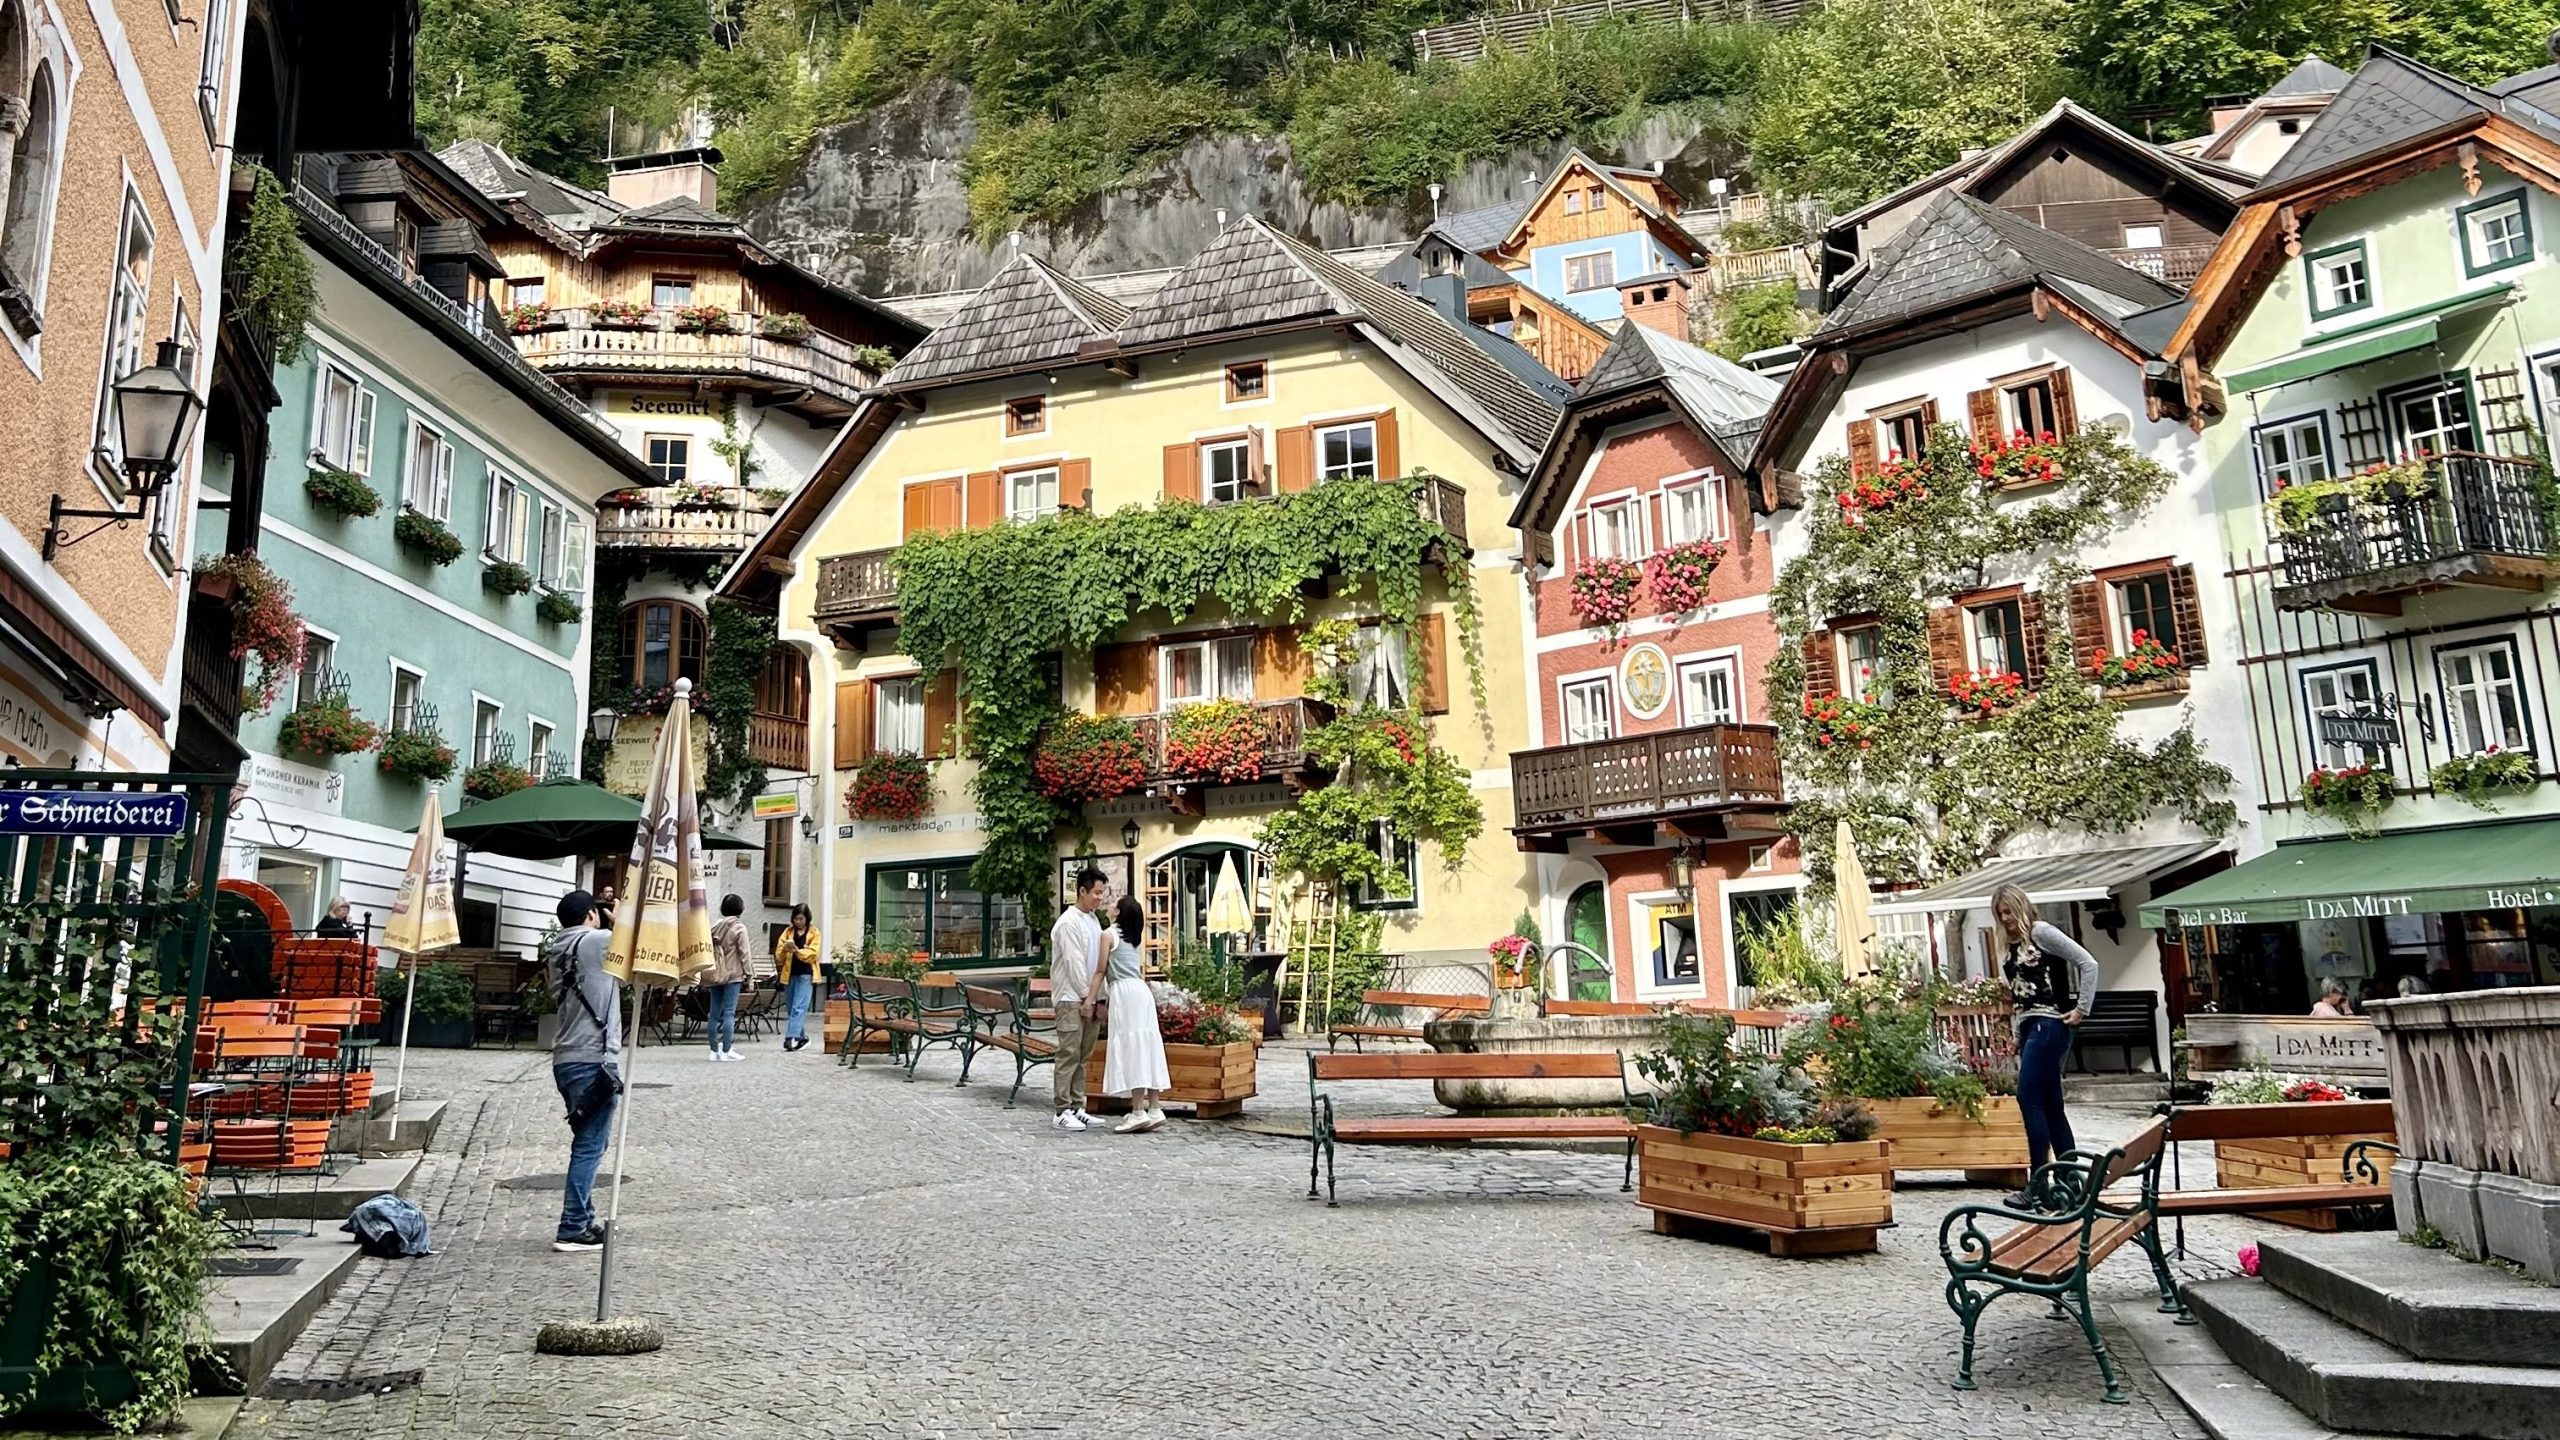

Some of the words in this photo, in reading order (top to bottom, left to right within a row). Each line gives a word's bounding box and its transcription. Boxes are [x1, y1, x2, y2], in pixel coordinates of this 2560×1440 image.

[630, 394, 710, 416] Seewirt
[2325, 719, 2353, 740] IDA
[2353, 720, 2392, 741] MITT
[616, 737, 650, 745] SEEWIRT
[293, 774, 320, 789] KERAMIK
[1219, 789, 1284, 806] SOUVENI
[20, 795, 175, 830] Schneiderei
[1101, 801, 1166, 816] ANDENKE
[879, 820, 952, 833] marktladen
[646, 876, 676, 902] IER.
[2486, 887, 2540, 909] Hotel
[427, 894, 447, 910] DAS
[1665, 903, 1687, 914] ATM
[2306, 898, 2348, 920] IDA
[2351, 895, 2412, 917] MITT
[2179, 910, 2202, 927] otel
[2220, 907, 2248, 924] Bar
[2276, 1034, 2312, 1056] IDA
[2320, 1034, 2373, 1057] MITT
